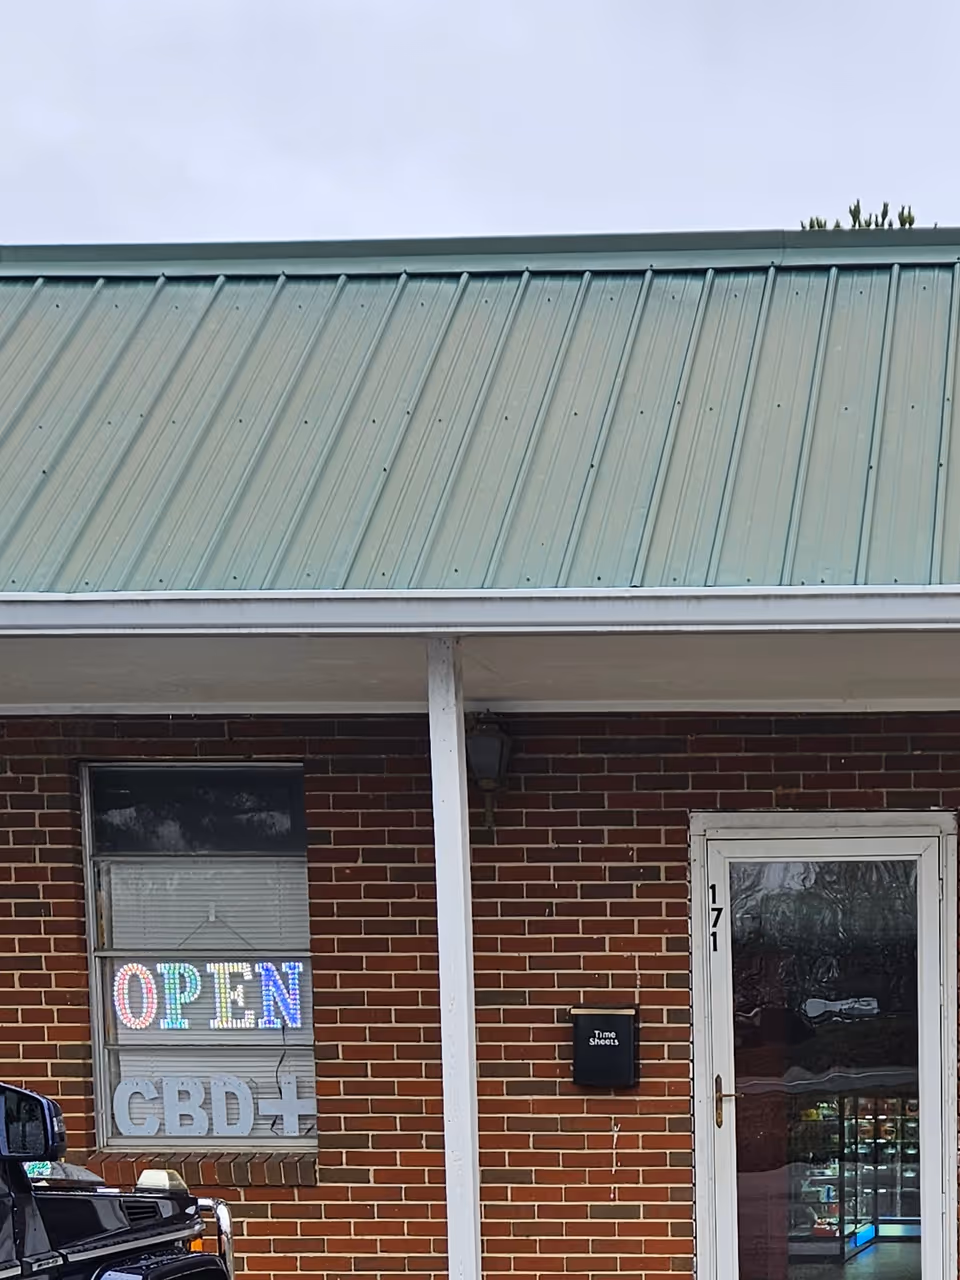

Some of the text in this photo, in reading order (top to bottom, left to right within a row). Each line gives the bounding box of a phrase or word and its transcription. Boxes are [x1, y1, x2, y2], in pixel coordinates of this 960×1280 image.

[709, 883, 724, 952] 171
[113, 962, 304, 1030] OPEN
[588, 1038, 620, 1046] Sheets
[593, 1030, 617, 1038] Time
